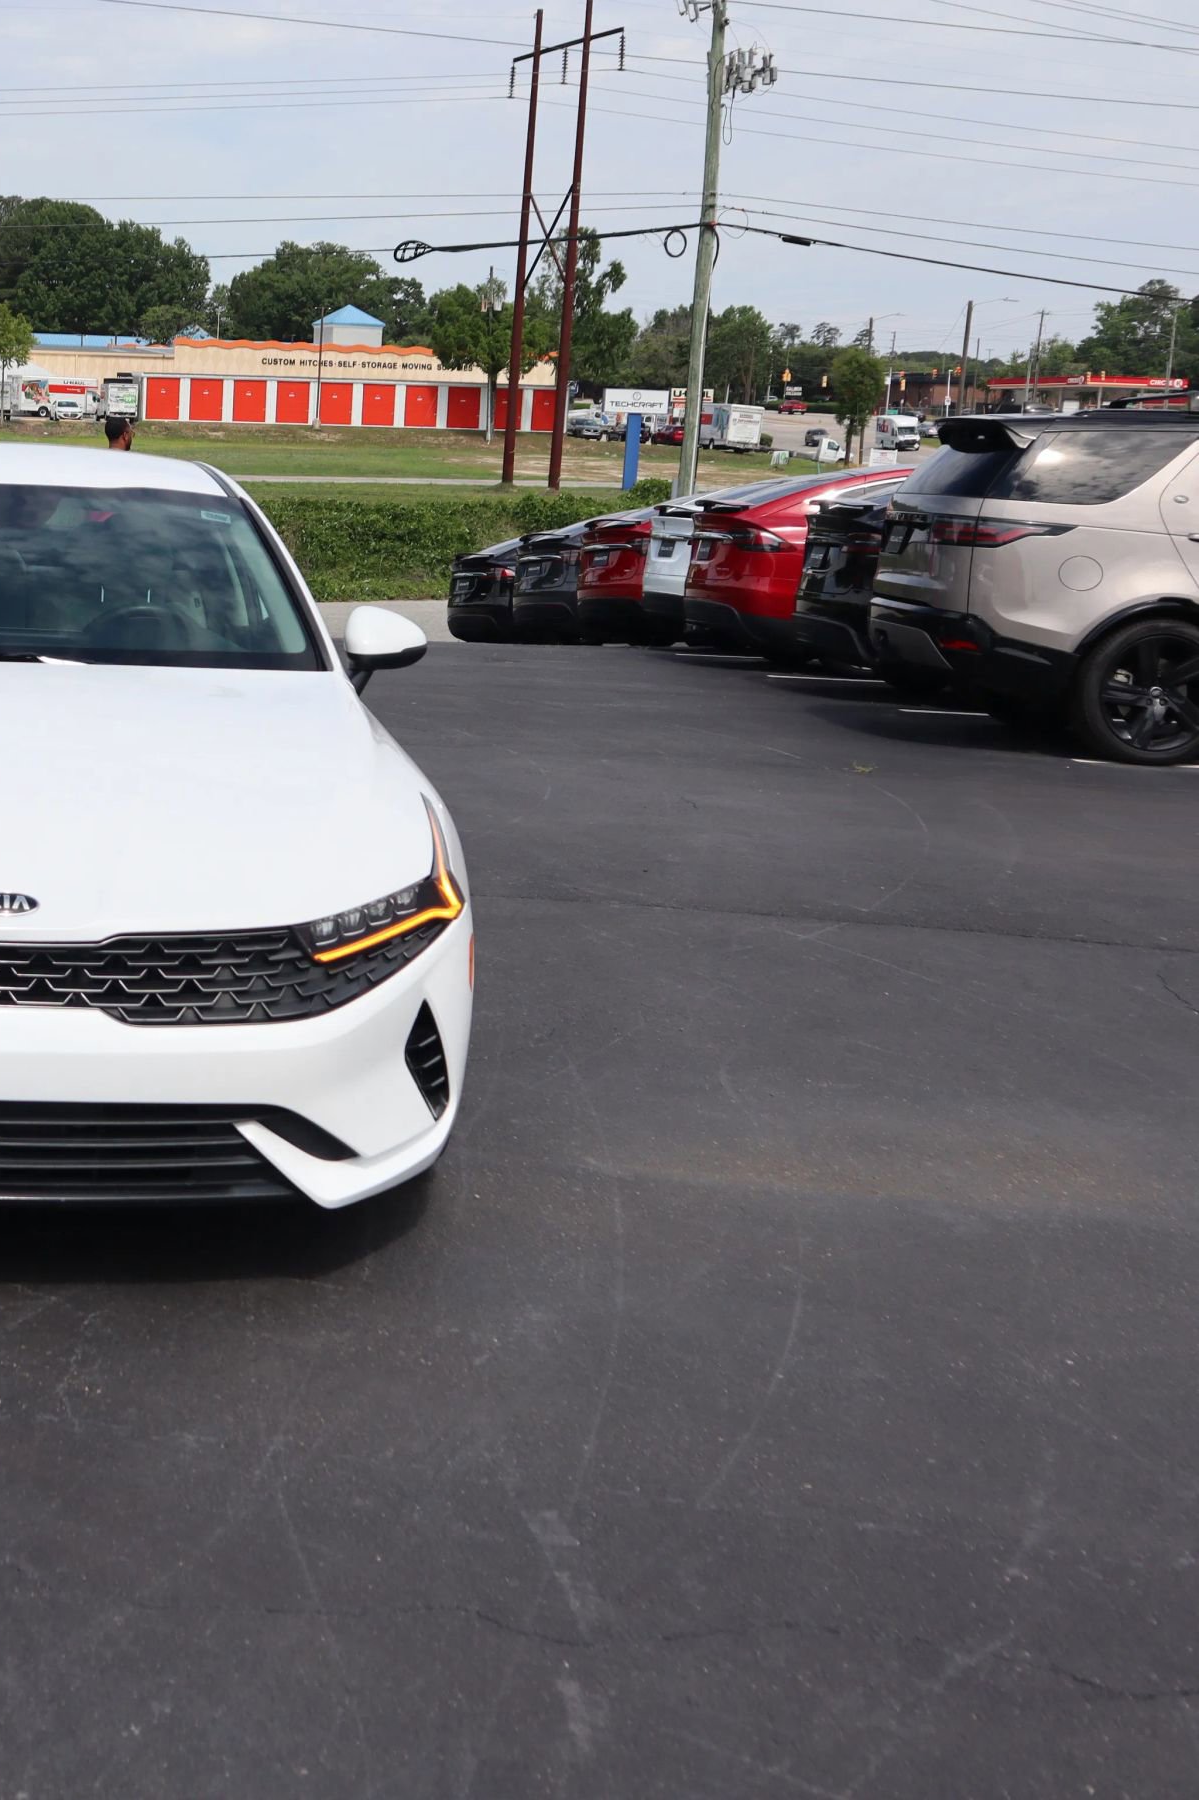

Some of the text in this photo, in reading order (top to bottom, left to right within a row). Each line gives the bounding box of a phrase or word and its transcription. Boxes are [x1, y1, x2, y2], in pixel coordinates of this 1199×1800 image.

[261, 357, 296, 366] CUSTOM
[299, 358, 334, 367] HITCHES
[337, 360, 357, 368] SELF
[361, 361, 398, 369] STORAGE
[402, 362, 433, 370] MOVING
[609, 400, 664, 409] TECHCRAFT
